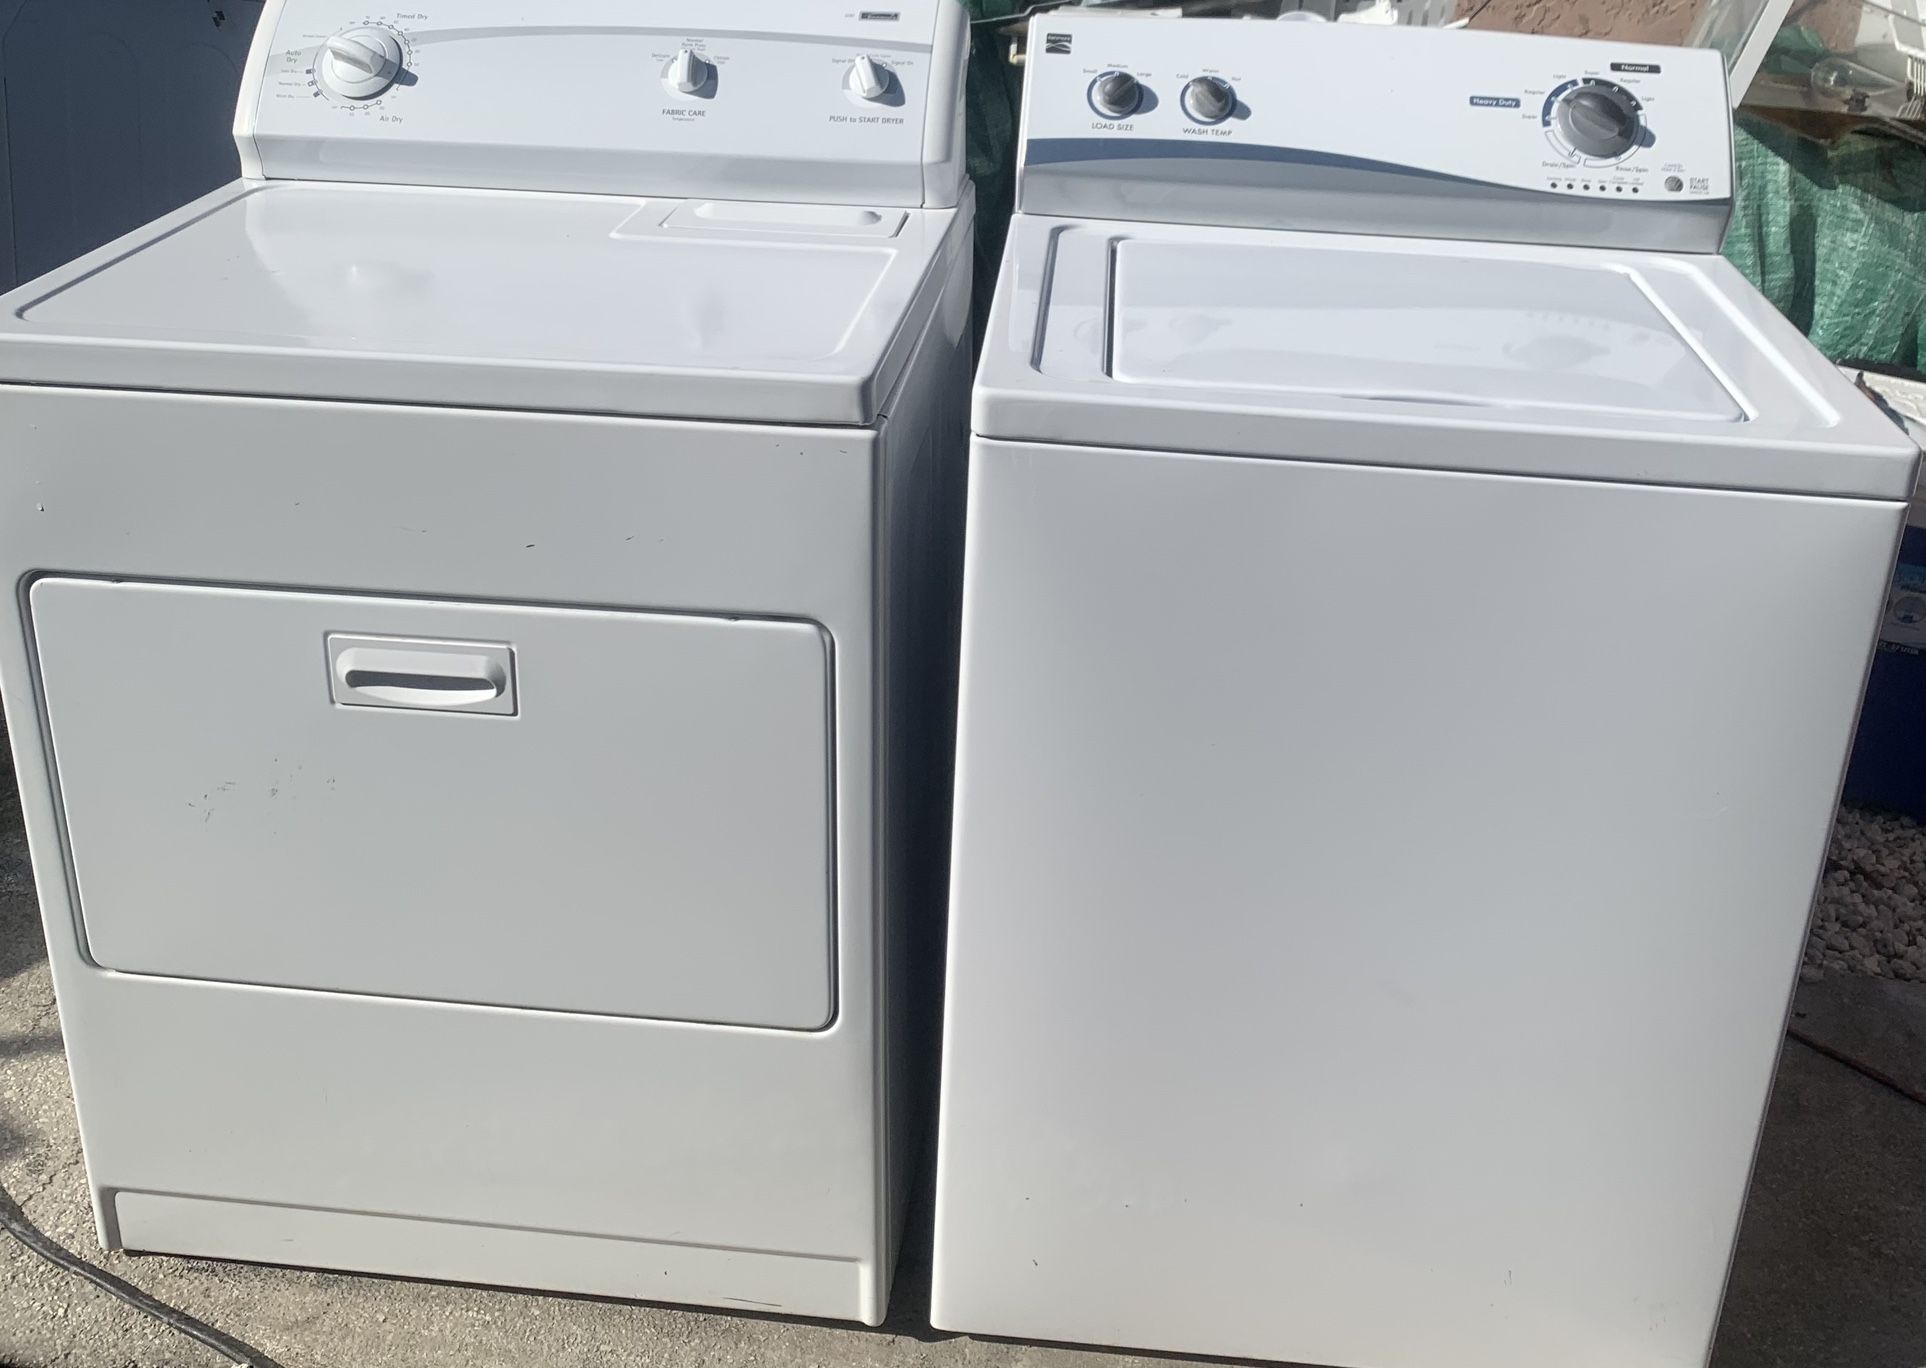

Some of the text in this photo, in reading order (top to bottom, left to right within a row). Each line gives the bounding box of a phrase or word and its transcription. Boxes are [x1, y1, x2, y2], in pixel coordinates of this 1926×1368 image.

[1621, 64, 1650, 72] Normal
[1473, 98, 1517, 108] Heavy Duty
[392, 116, 403, 124] Dry
[829, 115, 848, 123] PUSH
[882, 117, 904, 125] DRYER
[1091, 122, 1114, 130] LOAD
[1183, 127, 1233, 136] WASH TEMP
